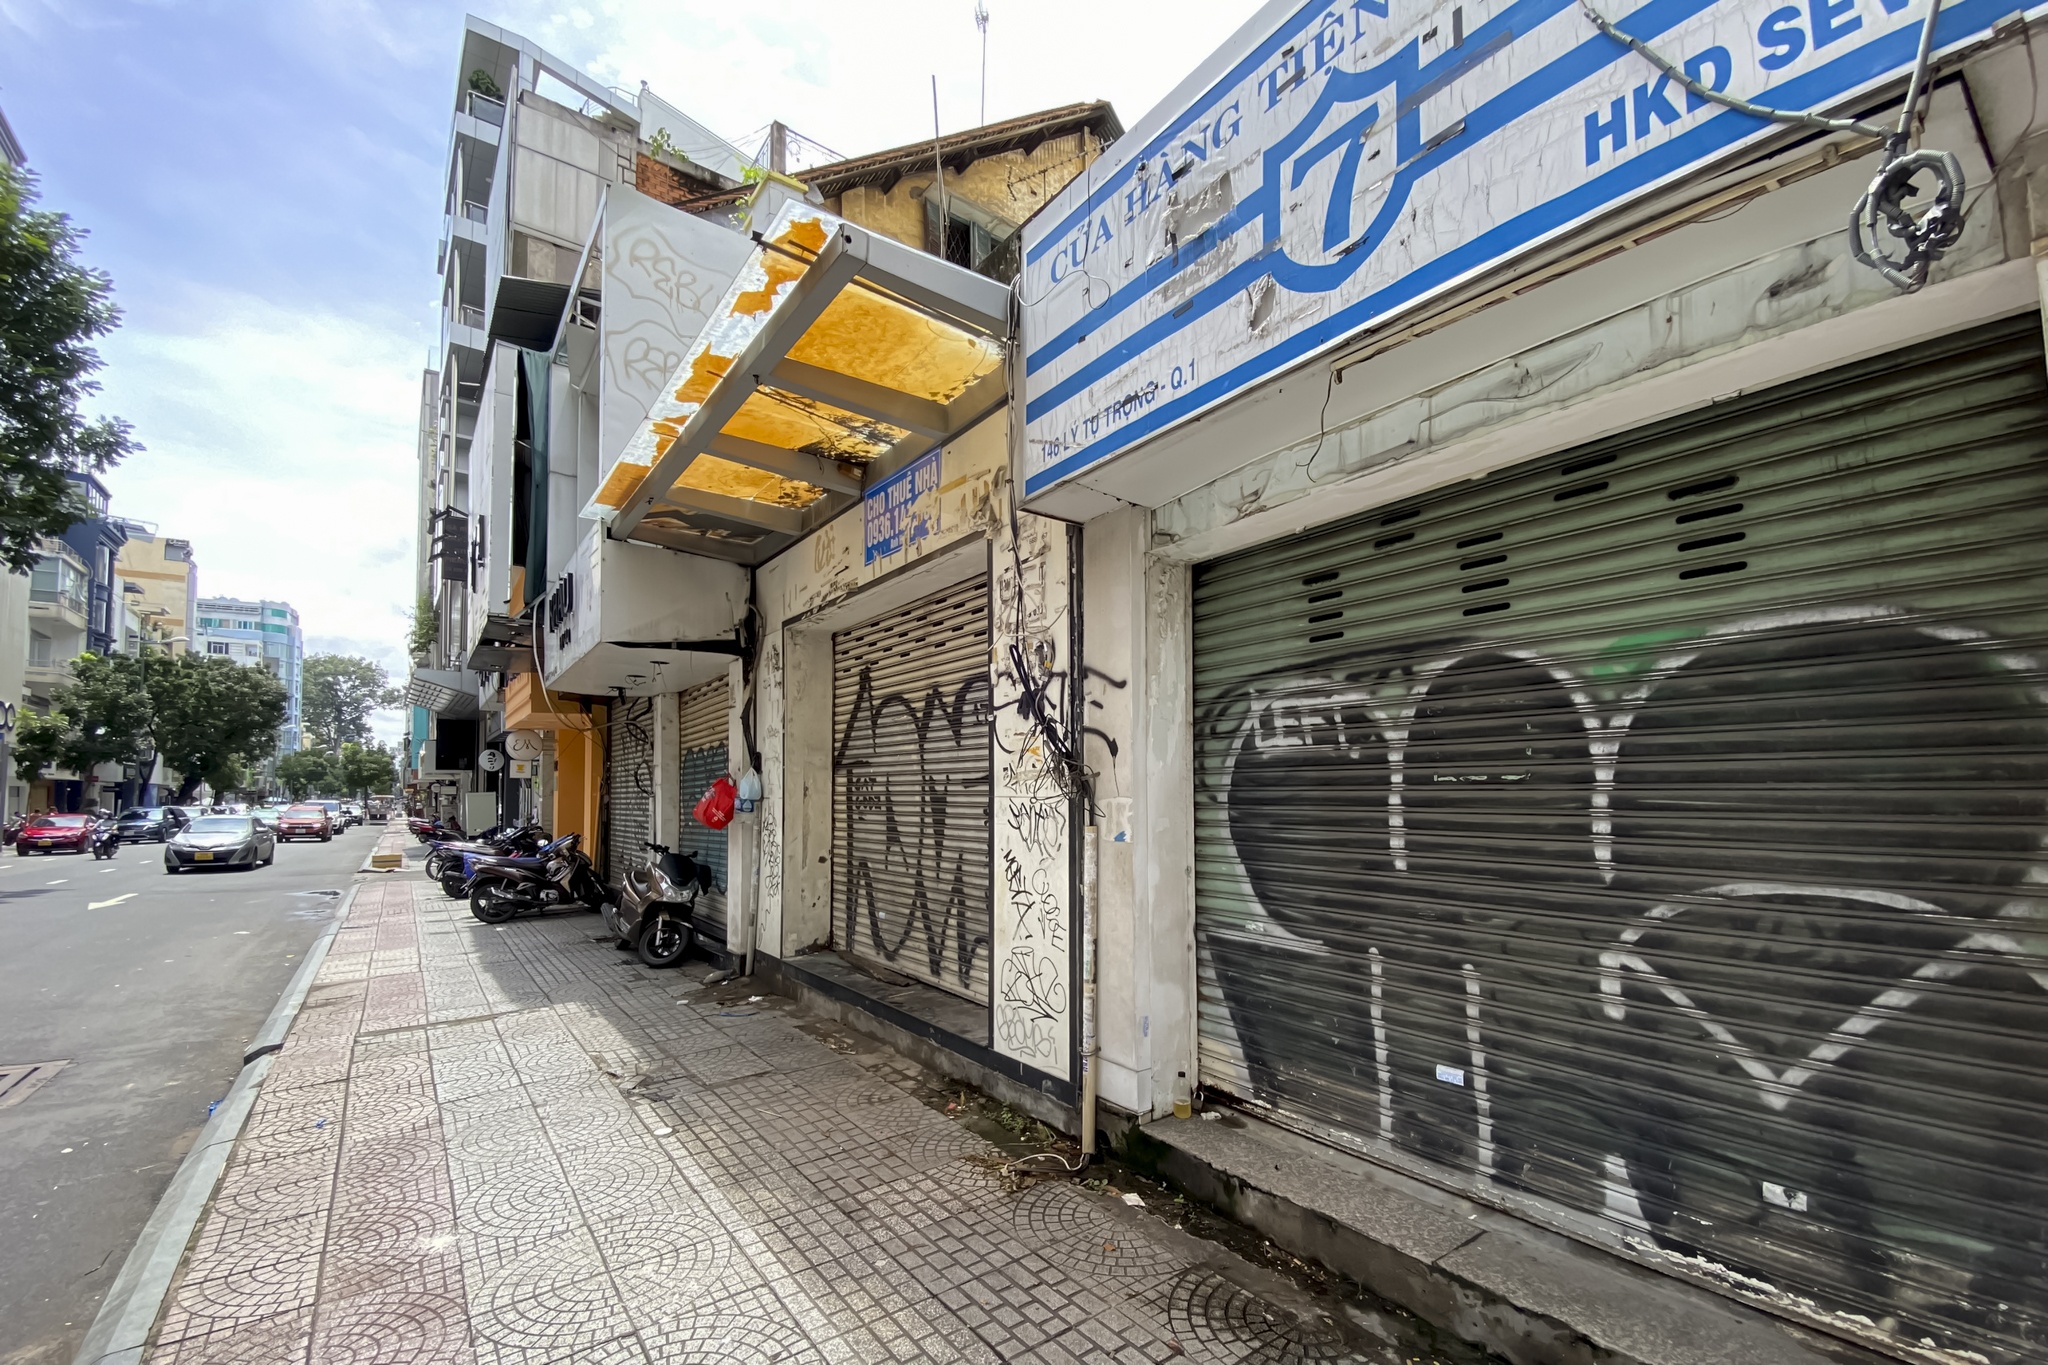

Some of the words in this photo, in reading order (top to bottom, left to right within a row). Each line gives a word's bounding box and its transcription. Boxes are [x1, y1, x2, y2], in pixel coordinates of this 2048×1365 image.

[1584, 44, 1733, 168] HKD
[1050, 214, 1114, 284] CỬA
[1124, 99, 1244, 228] HÀNG
[1041, 436, 1060, 462] 146
[1063, 420, 1079, 451] LÝ
[1171, 357, 1195, 391] Q.1
[867, 491, 886, 521] CHO
[887, 470, 913, 509] THUÊ
[915, 456, 938, 495] NHÀ
